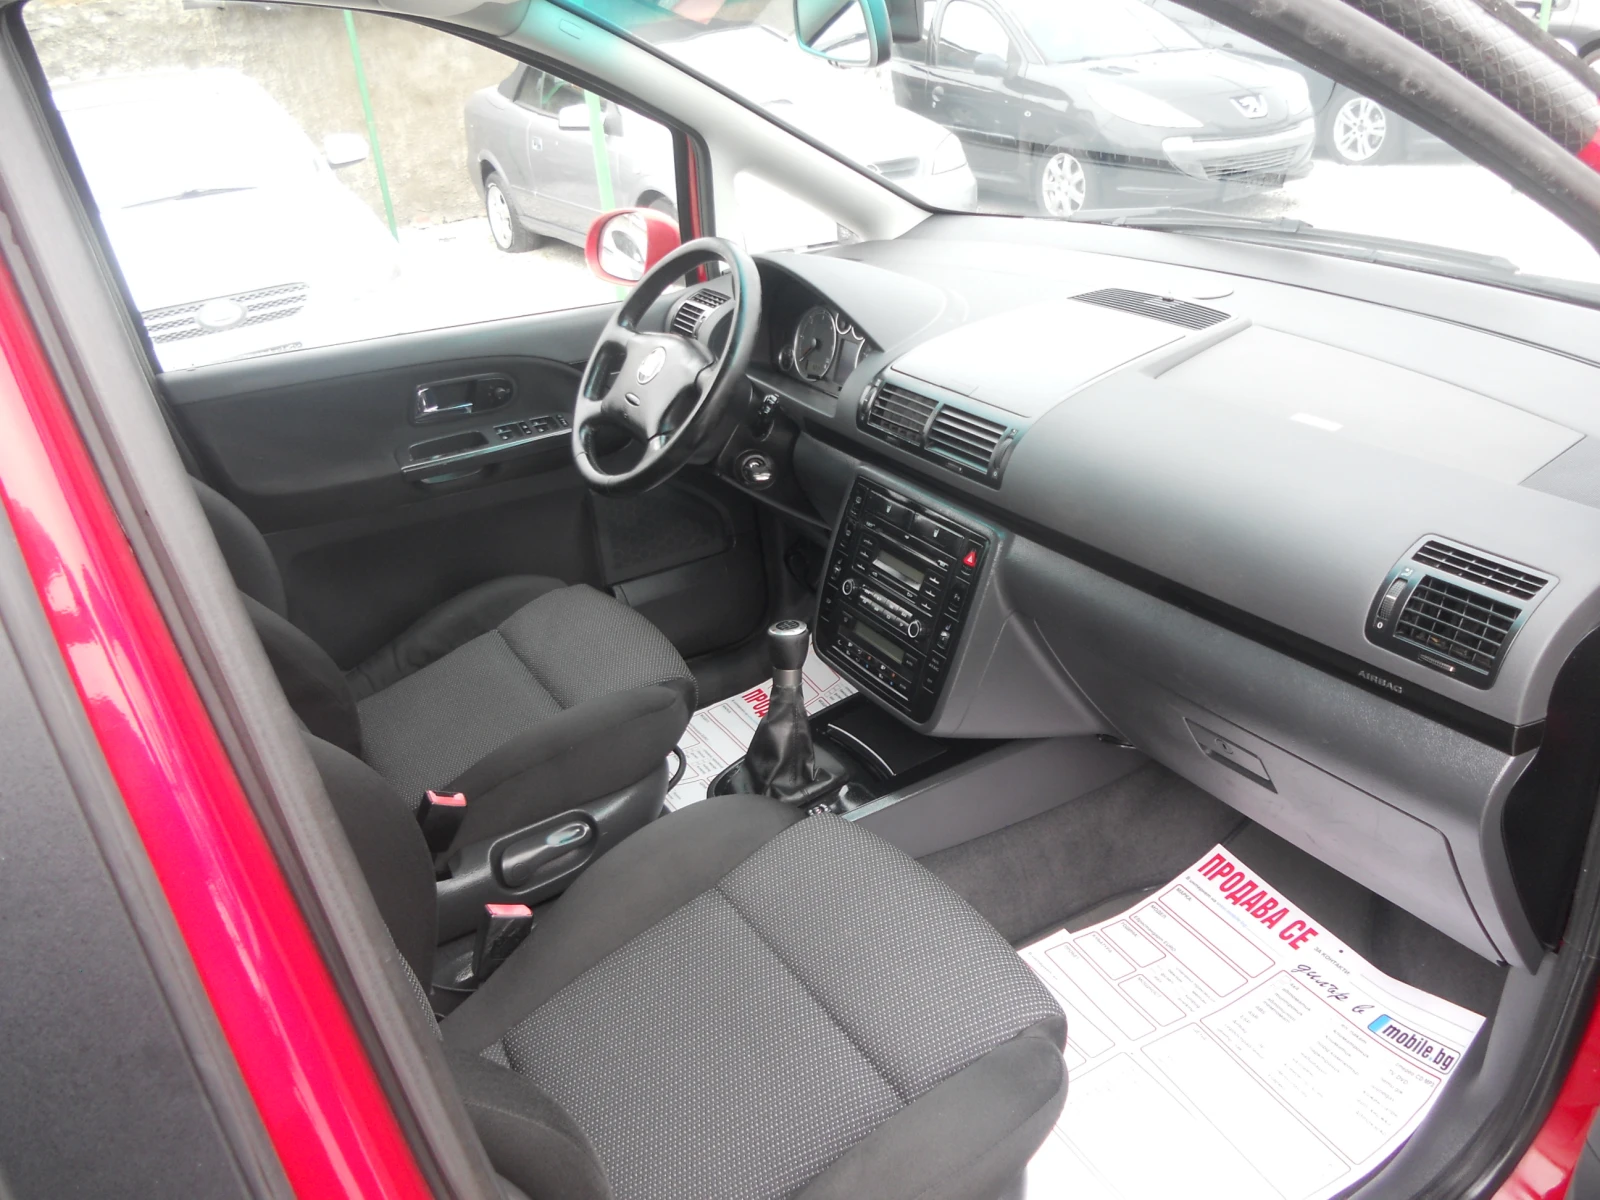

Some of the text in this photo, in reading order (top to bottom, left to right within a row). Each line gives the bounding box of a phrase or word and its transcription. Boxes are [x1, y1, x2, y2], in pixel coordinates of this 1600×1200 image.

[1358, 669, 1403, 694] AIRBAG
[742, 688, 771, 718] ПРОД
[1197, 852, 1320, 951] ПРОДАВА СЕ
[1313, 946, 1323, 954] ЗА
[1291, 963, 1350, 1002] дилър
[1381, 1023, 1455, 1071] mobile.bg
